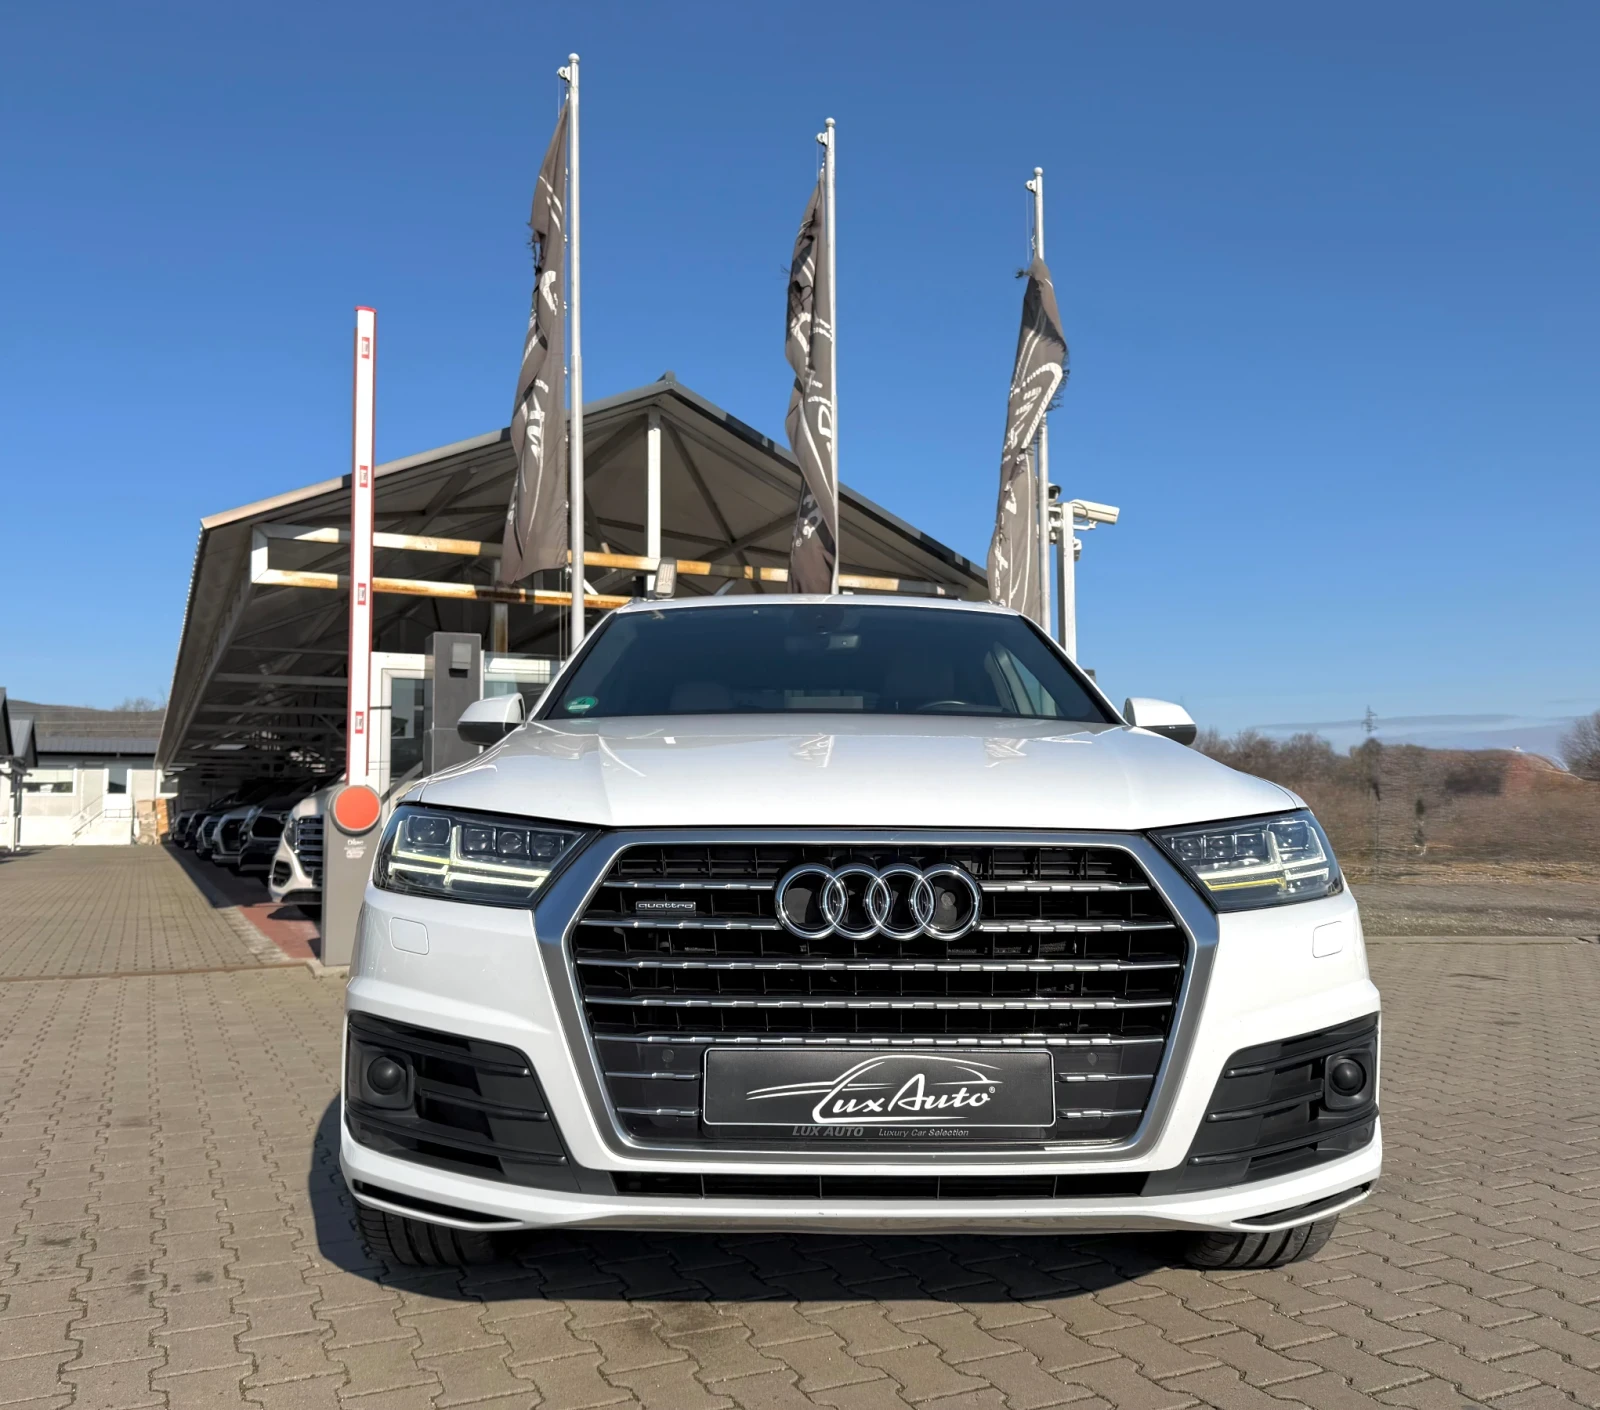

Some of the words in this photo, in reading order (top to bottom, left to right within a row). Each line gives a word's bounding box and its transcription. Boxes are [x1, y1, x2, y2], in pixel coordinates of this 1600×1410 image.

[792, 1126, 821, 1136] LUX
[823, 1126, 864, 1137] AUTO
[878, 1128, 909, 1138] Luxury
[911, 1128, 927, 1137] Car
[928, 1128, 969, 1137] Selection
